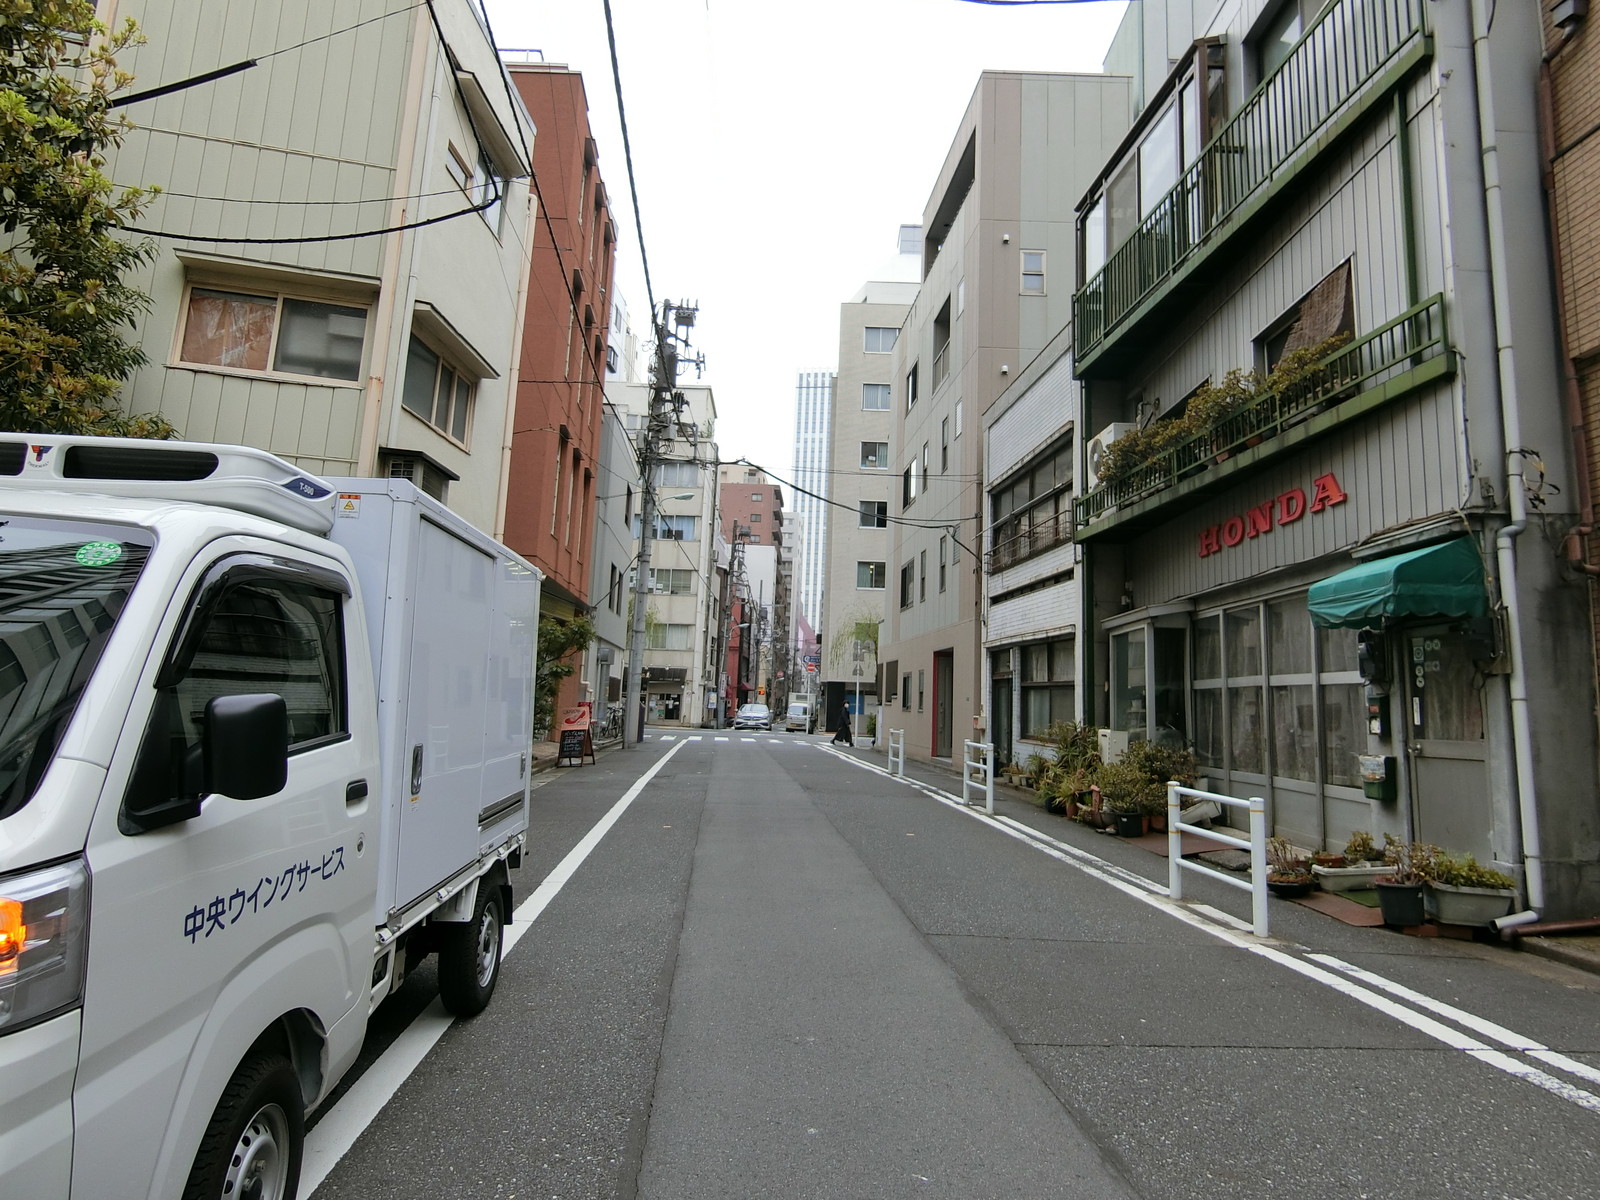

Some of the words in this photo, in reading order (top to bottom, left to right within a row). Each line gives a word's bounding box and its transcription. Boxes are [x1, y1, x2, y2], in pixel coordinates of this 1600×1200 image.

[299, 482, 315, 496] T-500
[1198, 473, 1347, 557] HONDA
[184, 846, 345, 944] 中央ウイングサービス
